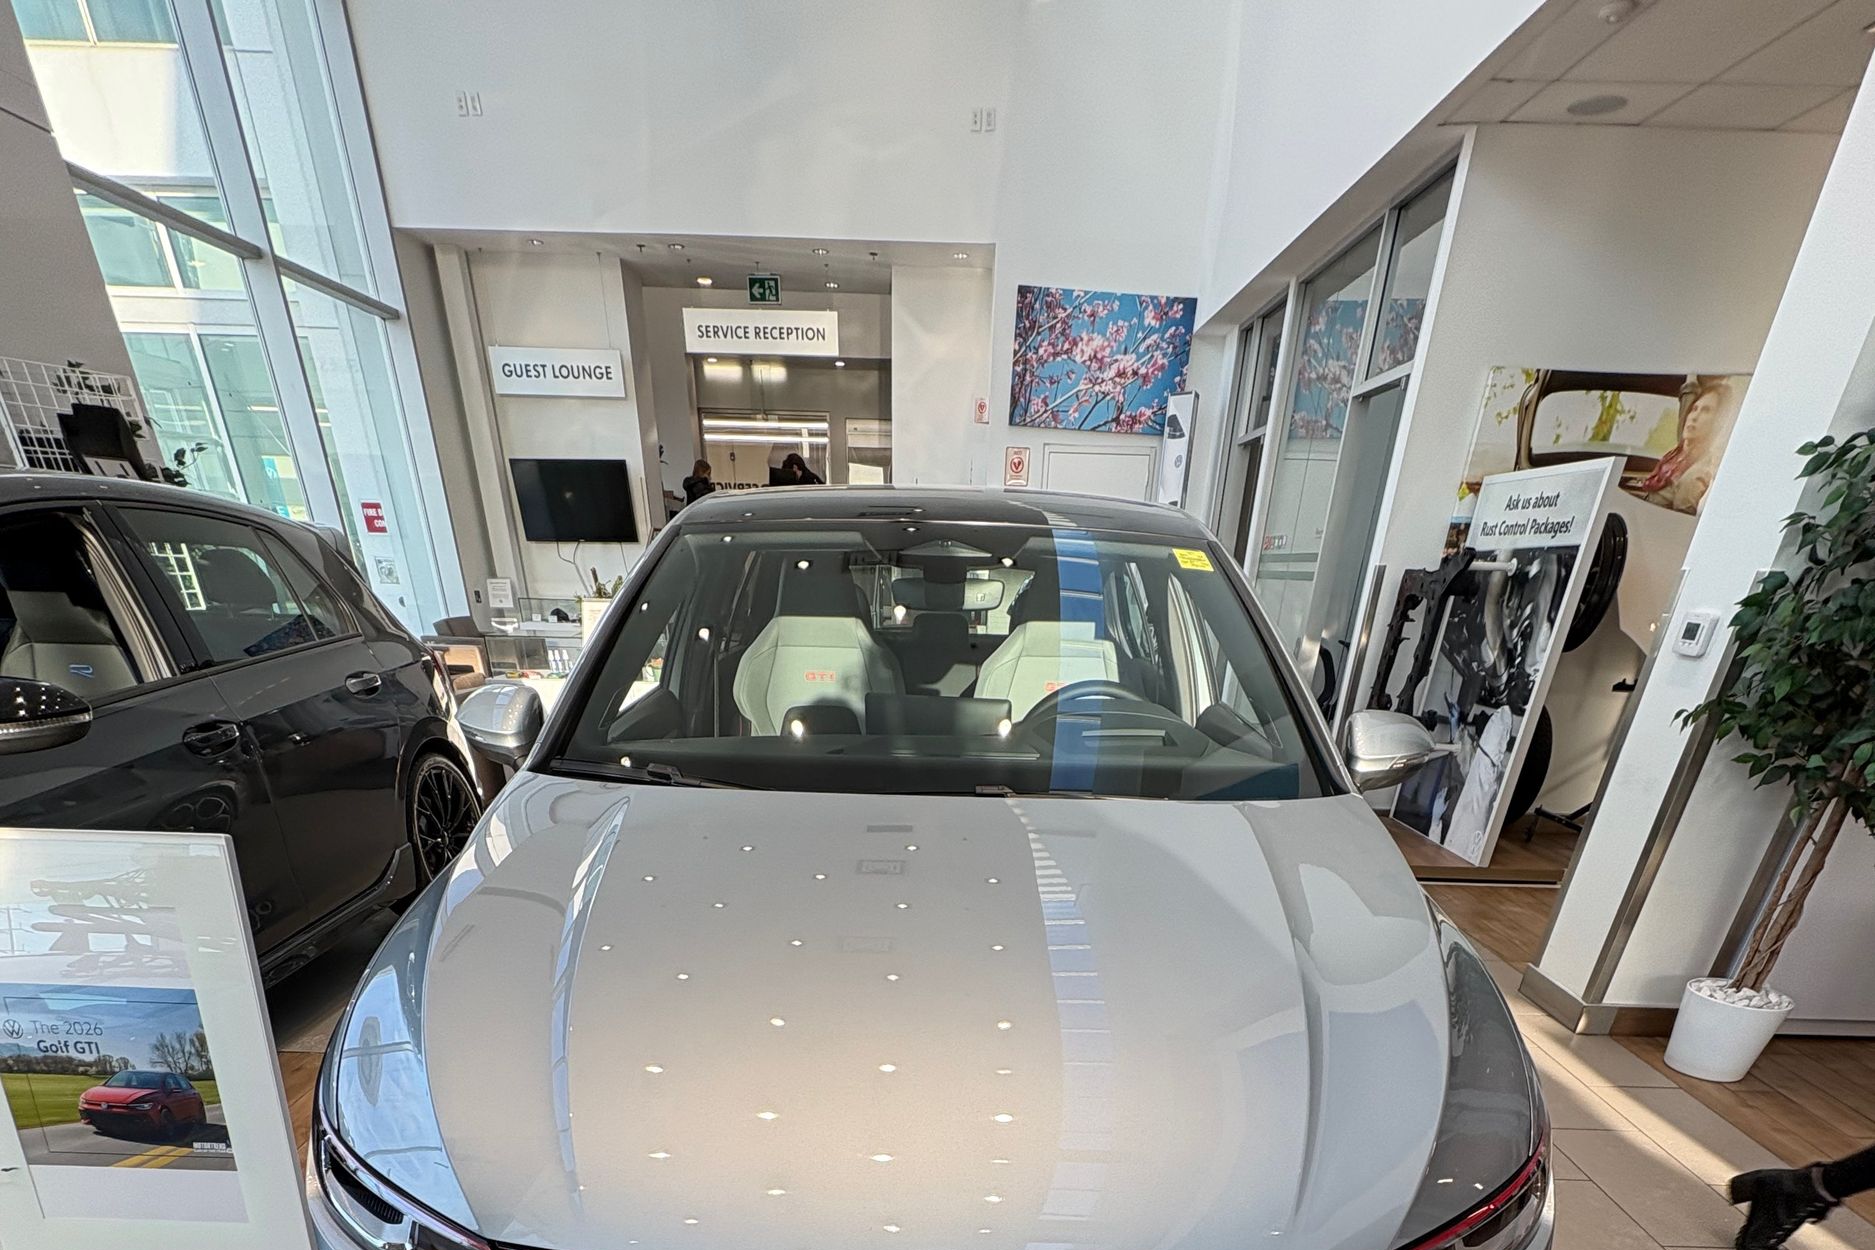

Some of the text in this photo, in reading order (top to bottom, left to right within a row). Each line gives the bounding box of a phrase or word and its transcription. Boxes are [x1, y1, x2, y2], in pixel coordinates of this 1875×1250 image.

[697, 325, 826, 341] SERVICE RECEPTION
[502, 363, 613, 380] GUEST LOUNGE
[1504, 491, 1560, 511] Ask us about
[1480, 515, 1576, 539] Rust Control Packages!
[804, 671, 835, 682] GTI
[29, 1020, 103, 1036] The 2026
[37, 1039, 100, 1055] Golf GTI
